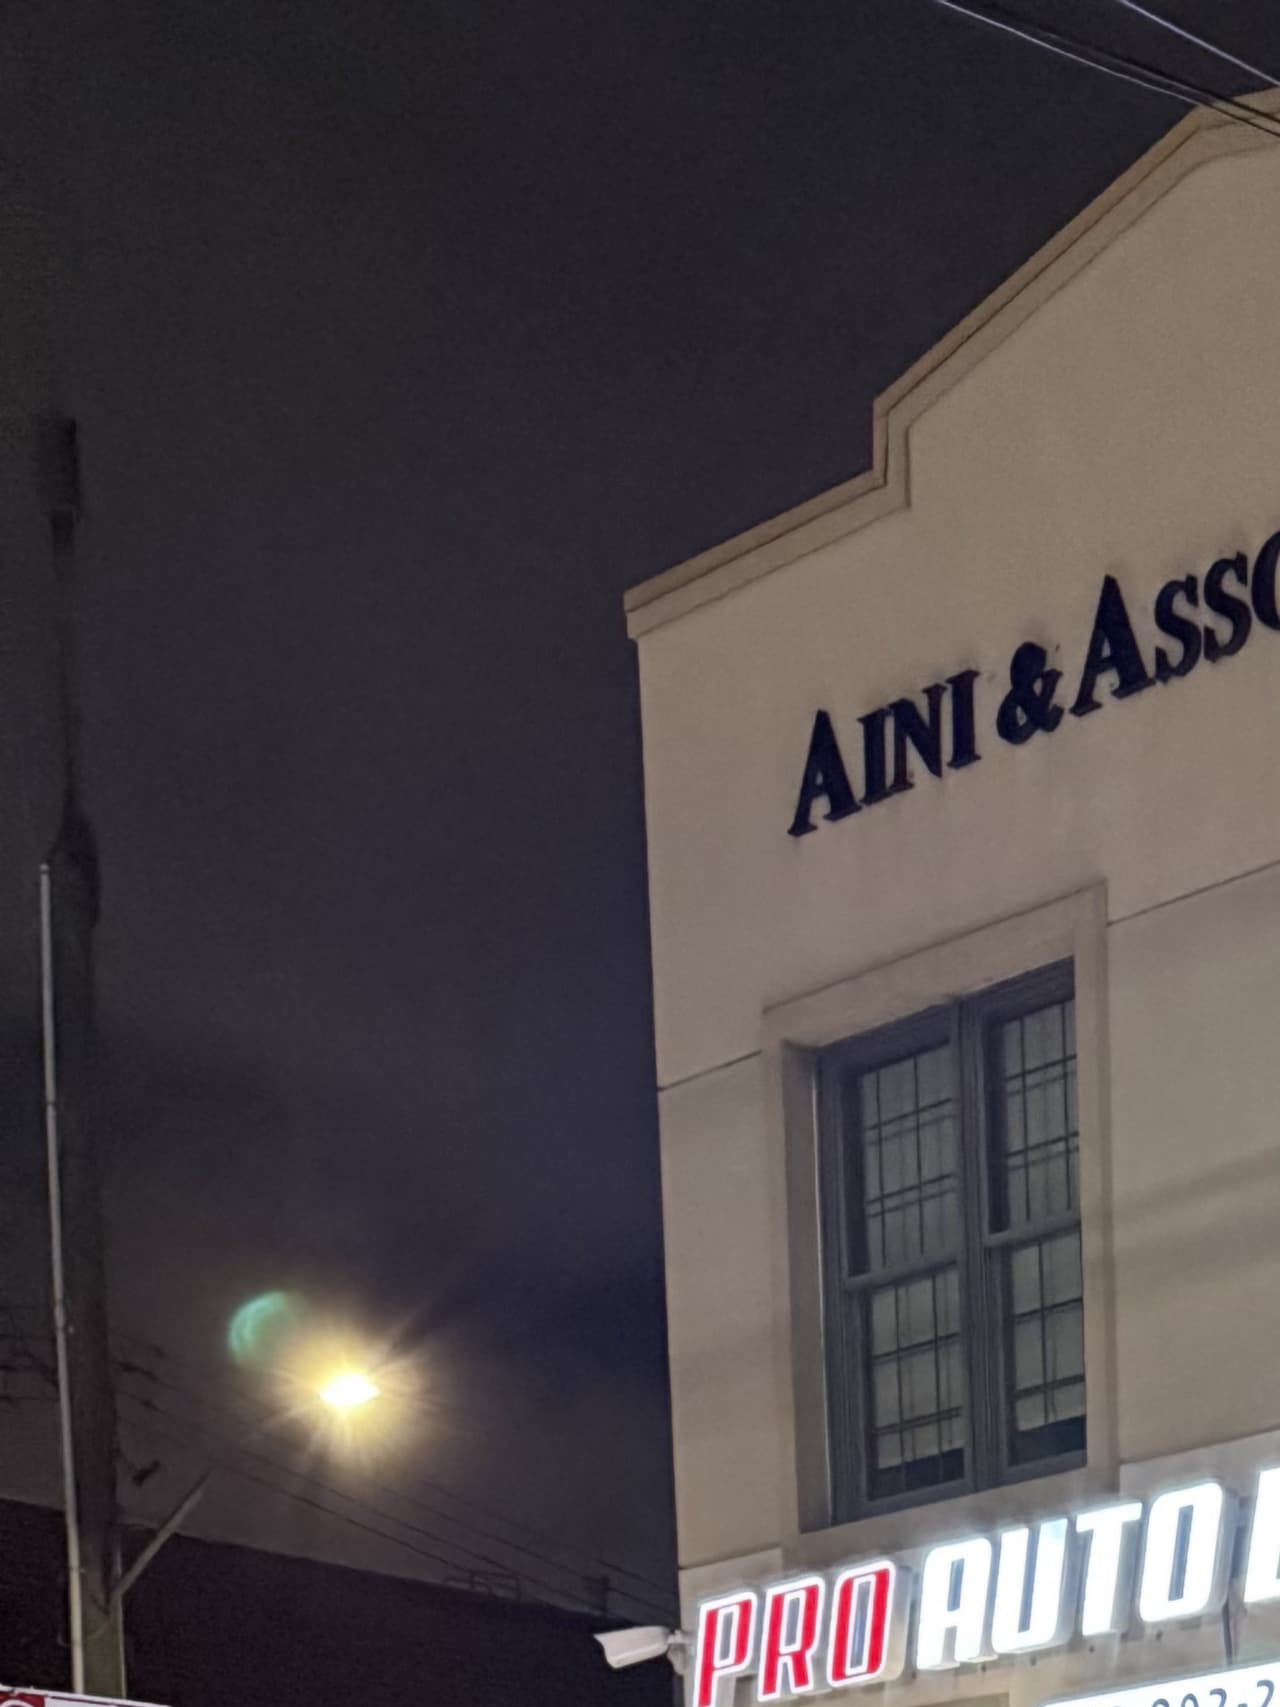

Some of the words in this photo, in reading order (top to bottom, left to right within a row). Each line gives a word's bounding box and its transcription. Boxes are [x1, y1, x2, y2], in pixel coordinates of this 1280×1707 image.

[787, 670, 980, 837] AINI
[996, 640, 1065, 746] &
[916, 1481, 1225, 1670] AUTO
